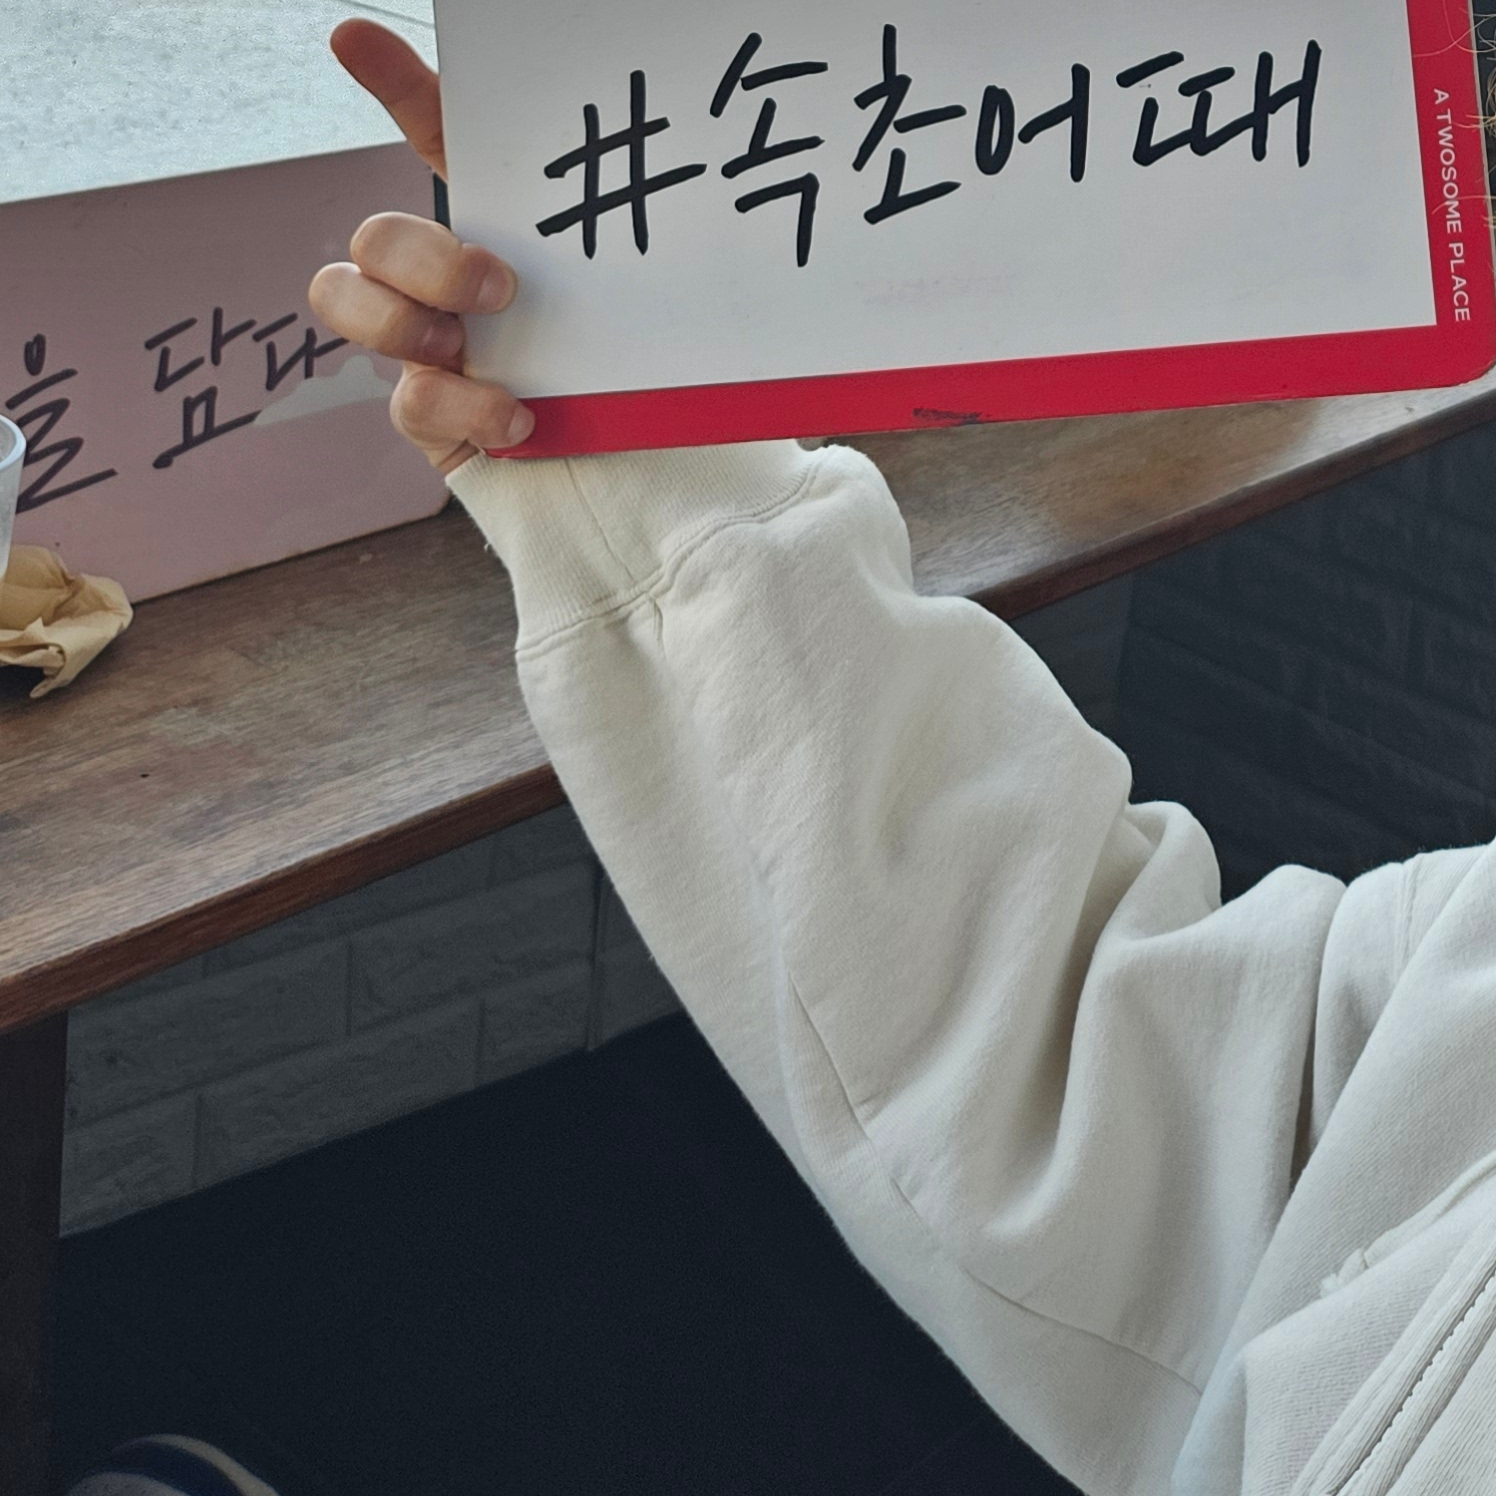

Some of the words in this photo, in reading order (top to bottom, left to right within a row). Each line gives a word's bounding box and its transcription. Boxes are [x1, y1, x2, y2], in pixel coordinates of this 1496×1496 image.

[535, 24, 1321, 268] #속초어때
[1433, 88, 1450, 105] A
[1436, 109, 1463, 234] TWOSOME
[1449, 242, 1471, 322] PLACE
